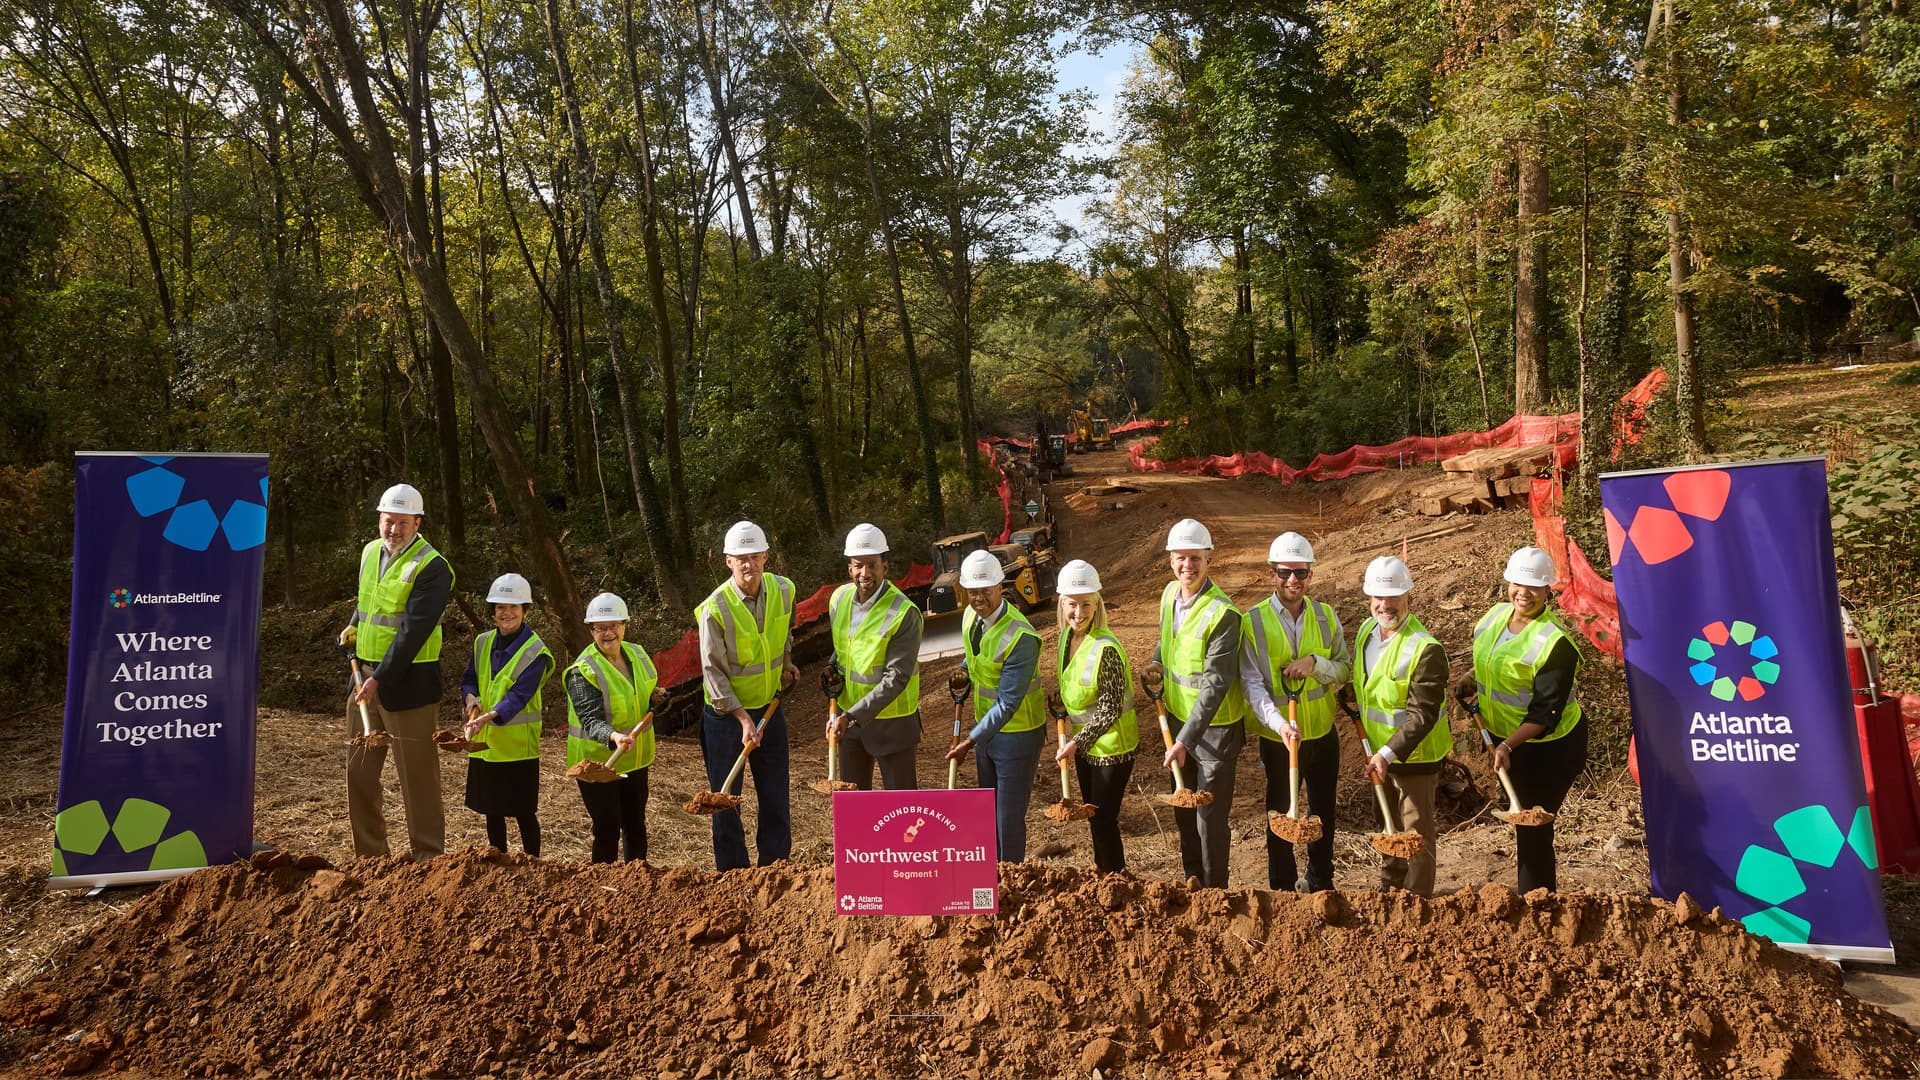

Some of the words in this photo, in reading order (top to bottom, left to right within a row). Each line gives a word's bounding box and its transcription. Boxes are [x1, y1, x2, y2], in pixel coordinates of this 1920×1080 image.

[115, 631, 212, 653] Where
[110, 661, 213, 683] Atlanta
[114, 691, 208, 712] Comes
[96, 718, 223, 747] Together
[1689, 711, 1793, 735] Atlanta
[1691, 738, 1798, 762] Beltline
[873, 805, 957, 832] GROUNDBREAKING
[845, 848, 939, 864] Northwest
[943, 846, 986, 862] Trail
[893, 869, 933, 880] Segment
[934, 869, 939, 878] 1
[858, 902, 883, 910] Beltline
